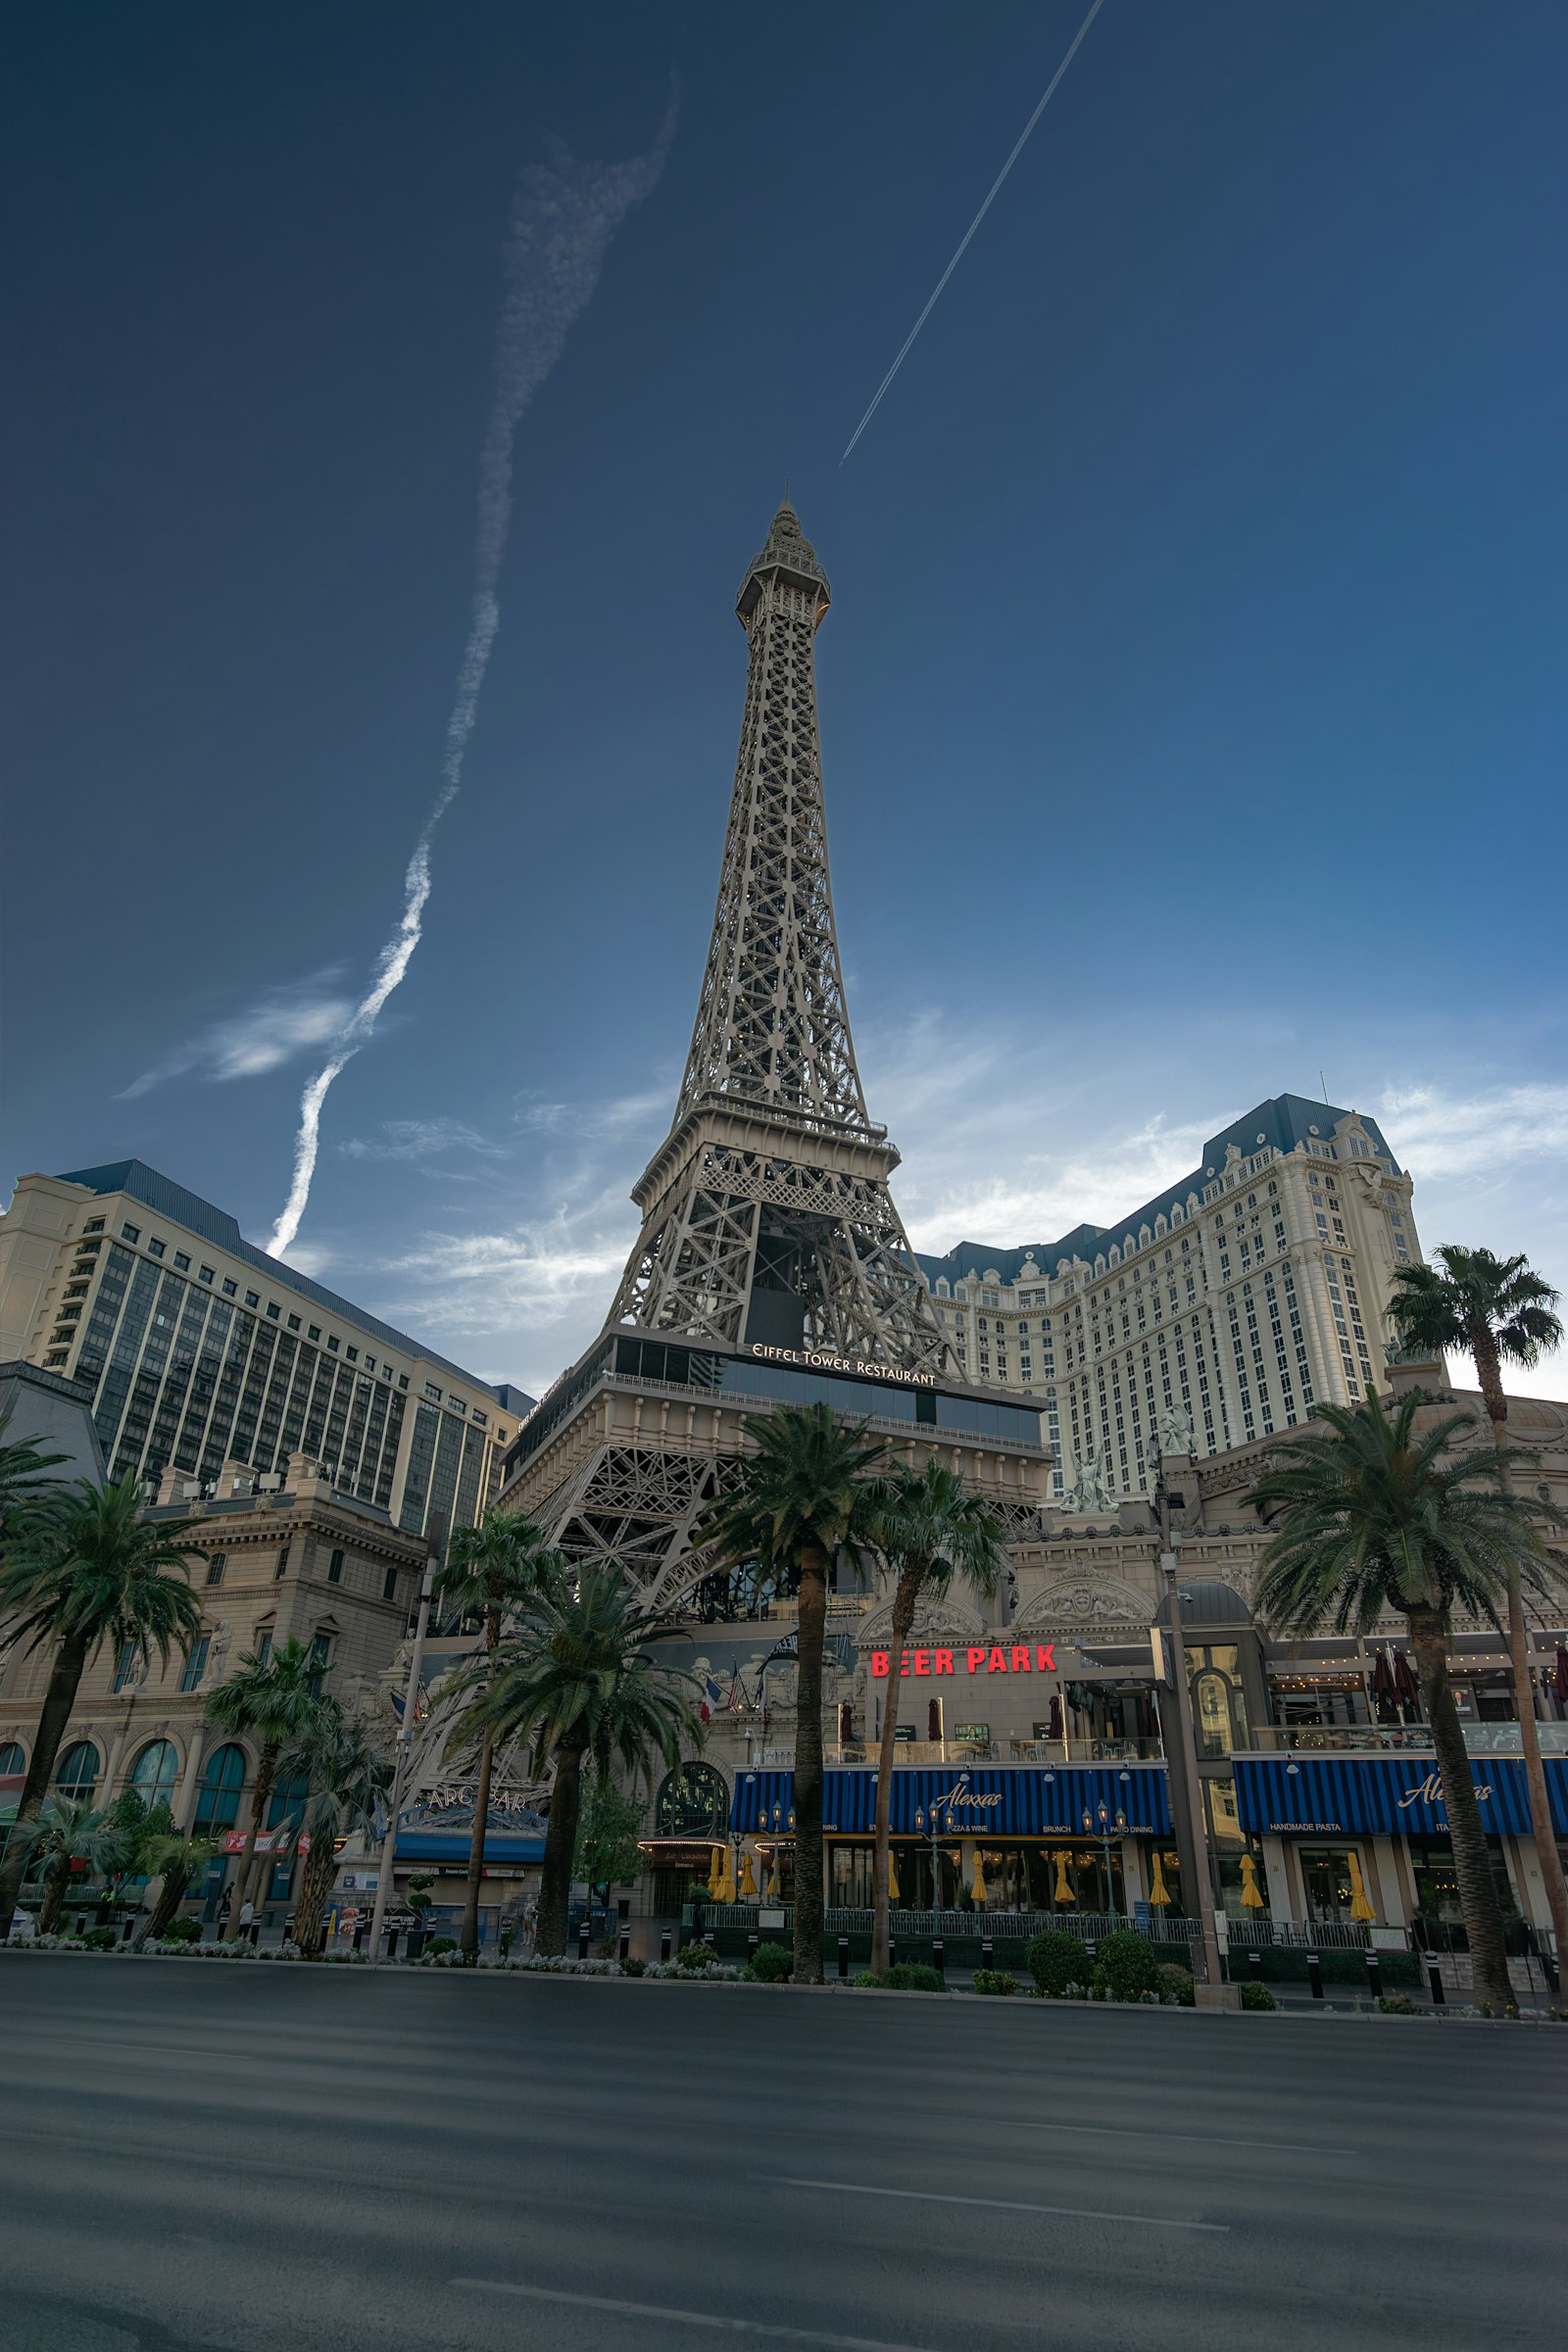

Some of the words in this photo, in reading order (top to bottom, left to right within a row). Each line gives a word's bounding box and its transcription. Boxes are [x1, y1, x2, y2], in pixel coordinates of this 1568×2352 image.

[753, 1344, 800, 1362] EIFFEL
[803, 1350, 851, 1371] TOWER
[857, 1361, 936, 1386] RESTAURANT
[871, 1648, 954, 1678] BEER
[966, 1643, 1057, 1674] PARK
[428, 1786, 473, 1809] ARC
[1315, 1823, 1342, 1832] PASTA
